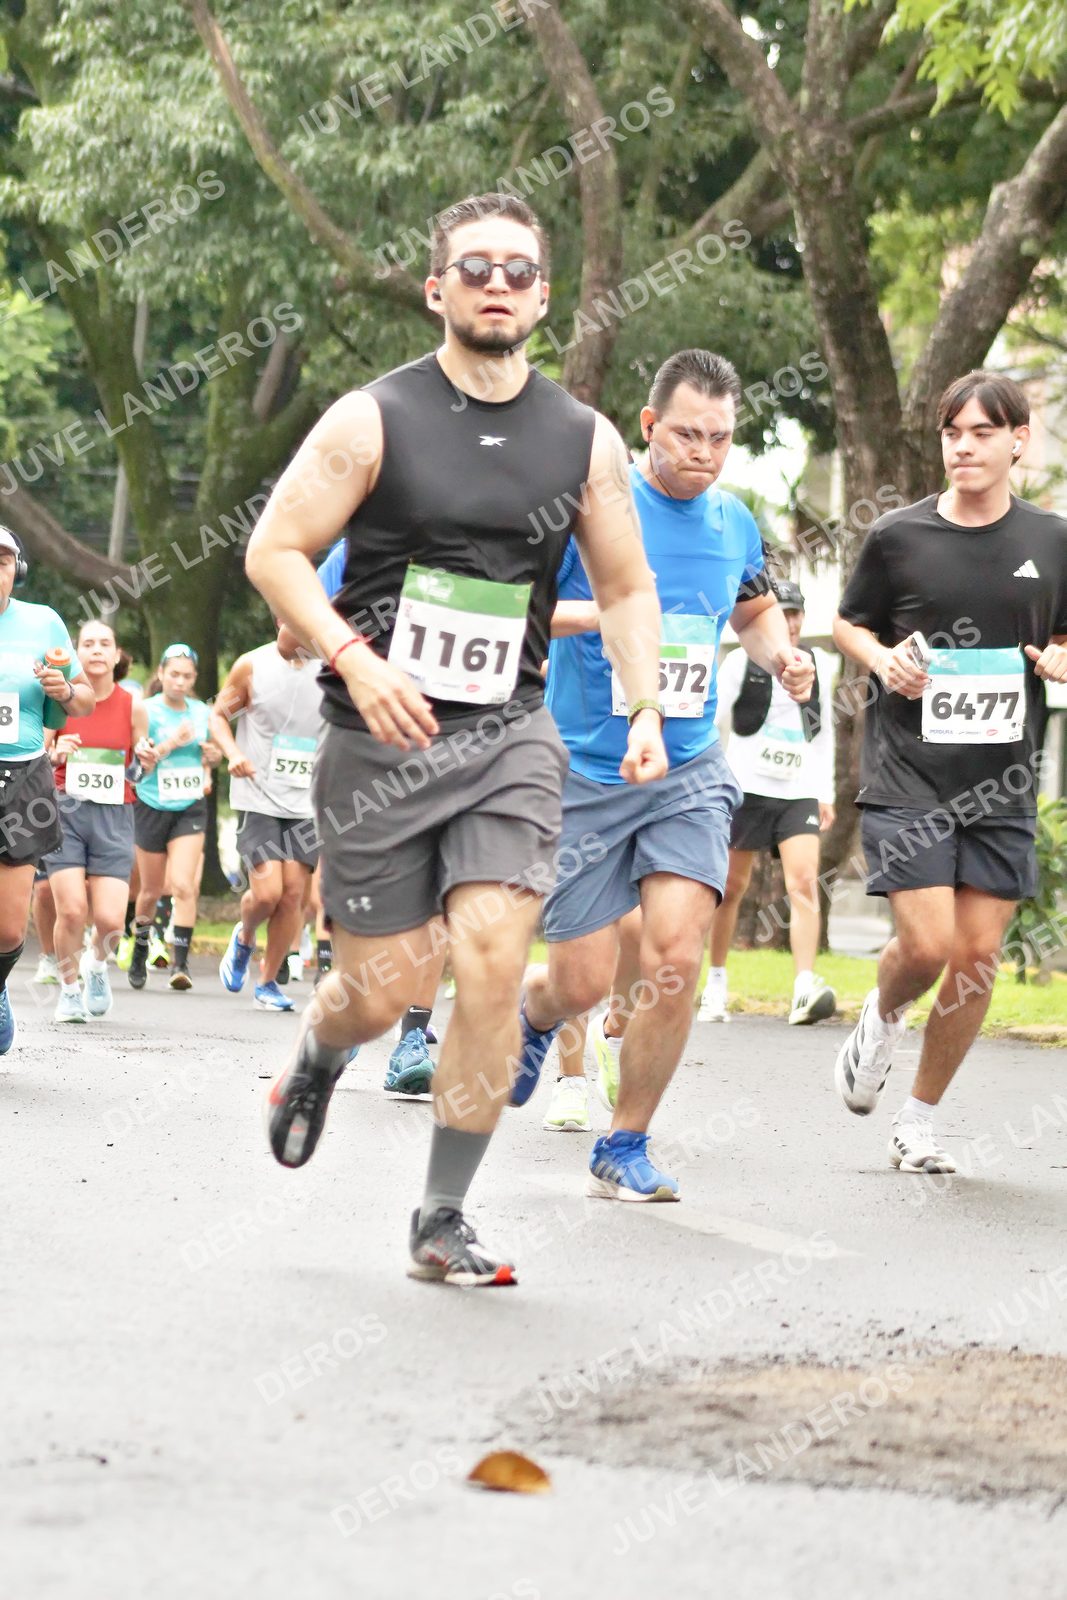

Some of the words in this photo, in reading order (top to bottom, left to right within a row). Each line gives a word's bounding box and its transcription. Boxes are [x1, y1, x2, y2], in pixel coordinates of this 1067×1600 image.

[408, 623, 510, 676] 1161
[930, 691, 1020, 721] 6477
[760, 747, 802, 768] 4670
[77, 773, 114, 789] 930
[162, 776, 201, 790] 5169
